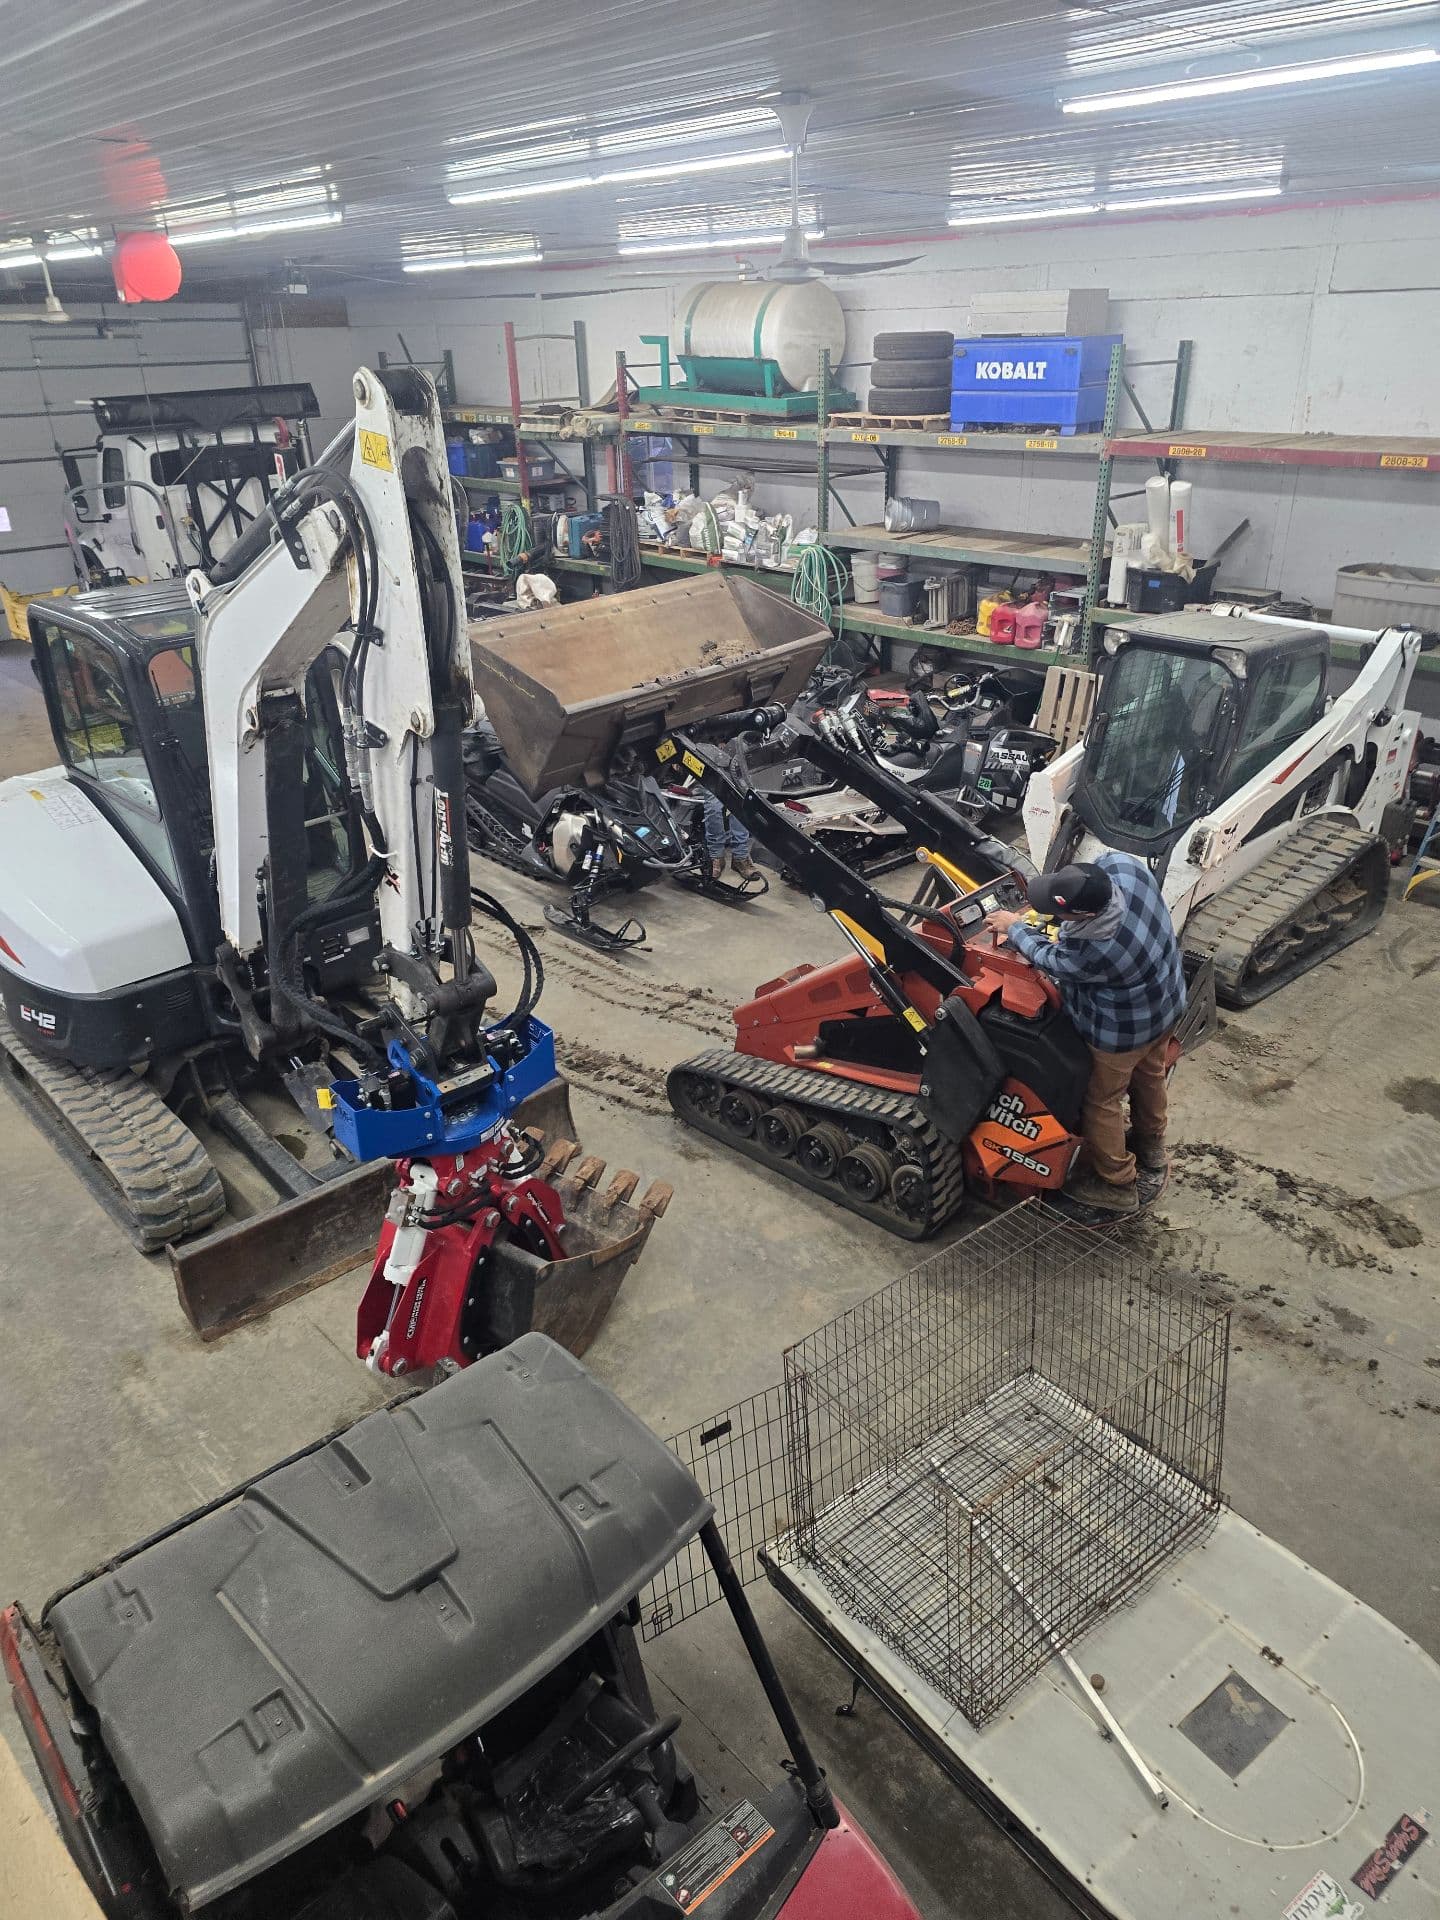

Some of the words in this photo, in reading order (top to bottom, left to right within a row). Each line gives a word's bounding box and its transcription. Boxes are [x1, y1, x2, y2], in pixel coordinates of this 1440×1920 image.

[975, 361, 1047, 380] KOBALT
[990, 751, 1029, 762] ASSAU
[20, 1004, 56, 1029] E42
